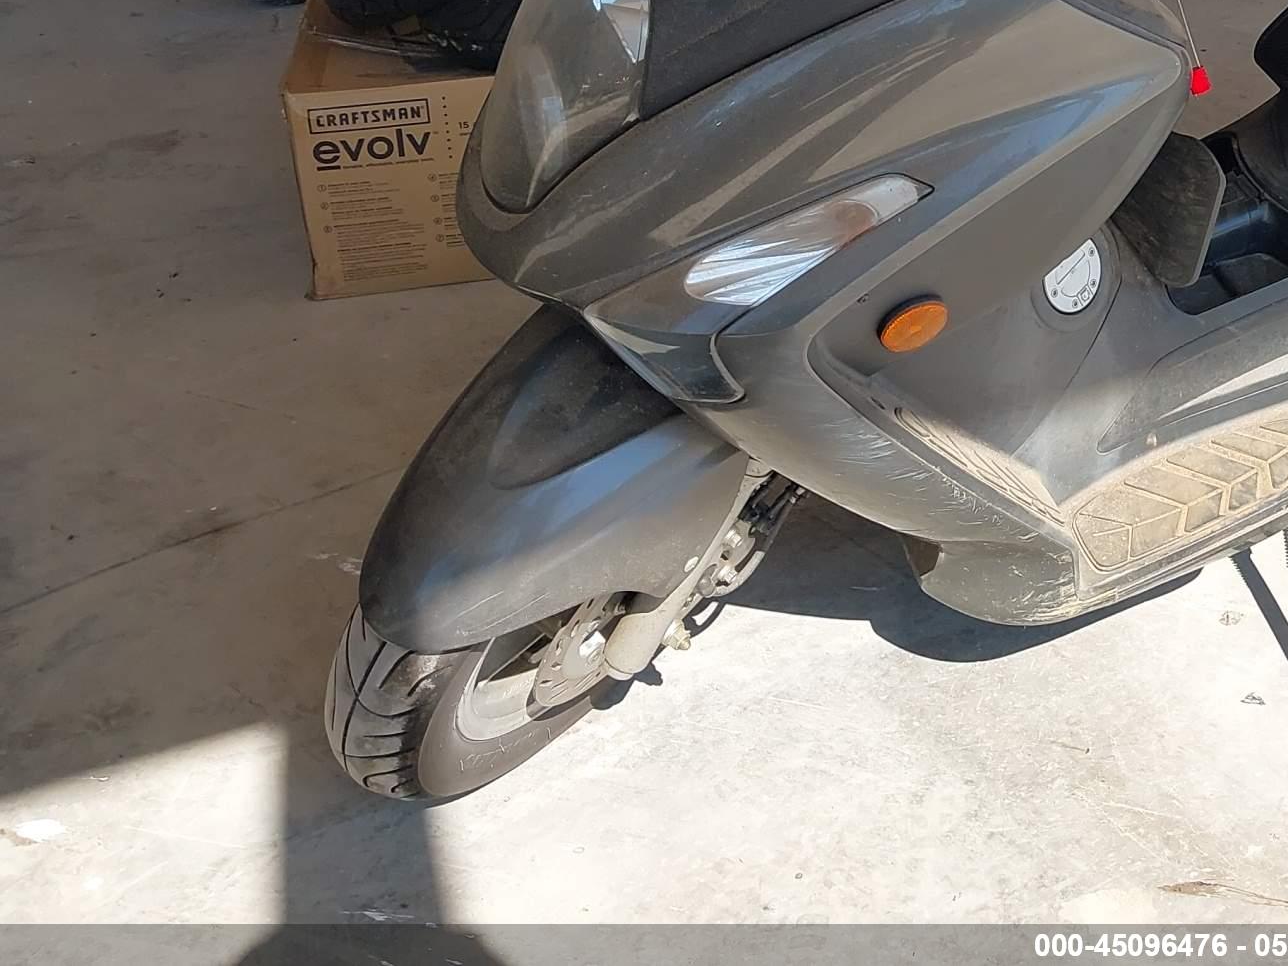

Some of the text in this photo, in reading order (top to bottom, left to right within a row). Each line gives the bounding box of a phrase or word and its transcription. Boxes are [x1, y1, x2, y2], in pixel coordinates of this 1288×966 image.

[316, 105, 423, 128] CRAFTSMAN
[458, 121, 470, 129] 15
[313, 128, 431, 164] evolv
